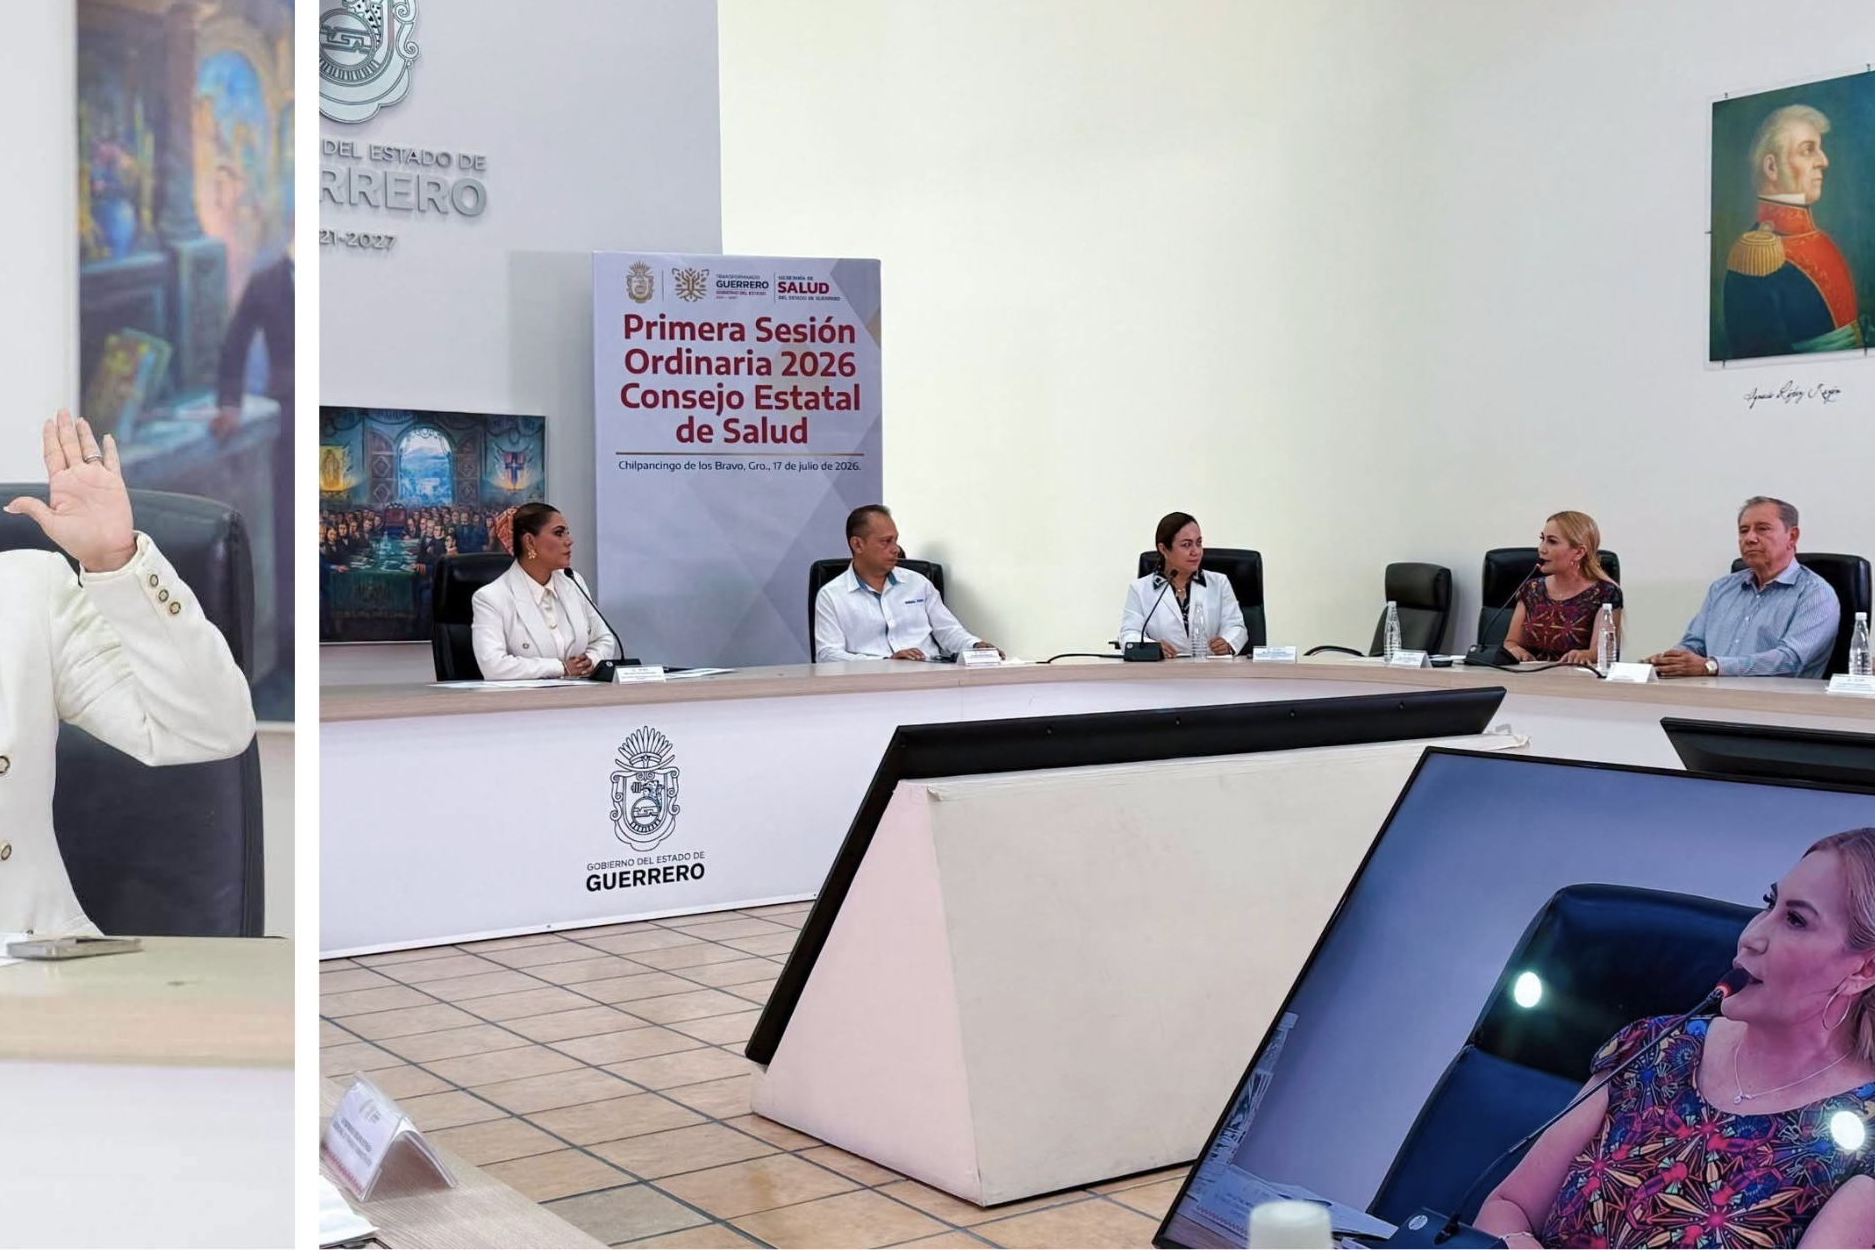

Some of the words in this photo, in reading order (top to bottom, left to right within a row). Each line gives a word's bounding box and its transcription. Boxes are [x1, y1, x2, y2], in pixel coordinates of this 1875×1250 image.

[321, 138, 363, 160] DEL
[369, 143, 453, 169] ESTADO
[458, 153, 487, 171] DE
[715, 280, 769, 289] GUERRERO
[777, 282, 830, 294] SALUD
[624, 313, 745, 341] Primera
[756, 316, 855, 343] Sesión
[625, 347, 772, 376] Ordinaria
[781, 351, 856, 377] 2026
[621, 383, 745, 416] Consejo
[755, 383, 860, 411] Estatal
[676, 415, 713, 443] de
[723, 416, 808, 444] Salud
[618, 460, 682, 472] Chilpancingo
[684, 461, 696, 470] de
[699, 461, 712, 470] los
[715, 461, 746, 471] Bravo,
[748, 461, 771, 471] Gro.,
[773, 461, 782, 470] 17
[785, 461, 797, 470] de
[798, 461, 819, 472] julio
[821, 461, 833, 470] de
[835, 461, 862, 471] 2026.
[587, 859, 635, 871] GOBIERNO
[637, 857, 654, 866] DEL
[657, 852, 691, 864] ESTADO
[693, 851, 706, 859] DE
[586, 863, 705, 892] GUERRERO
